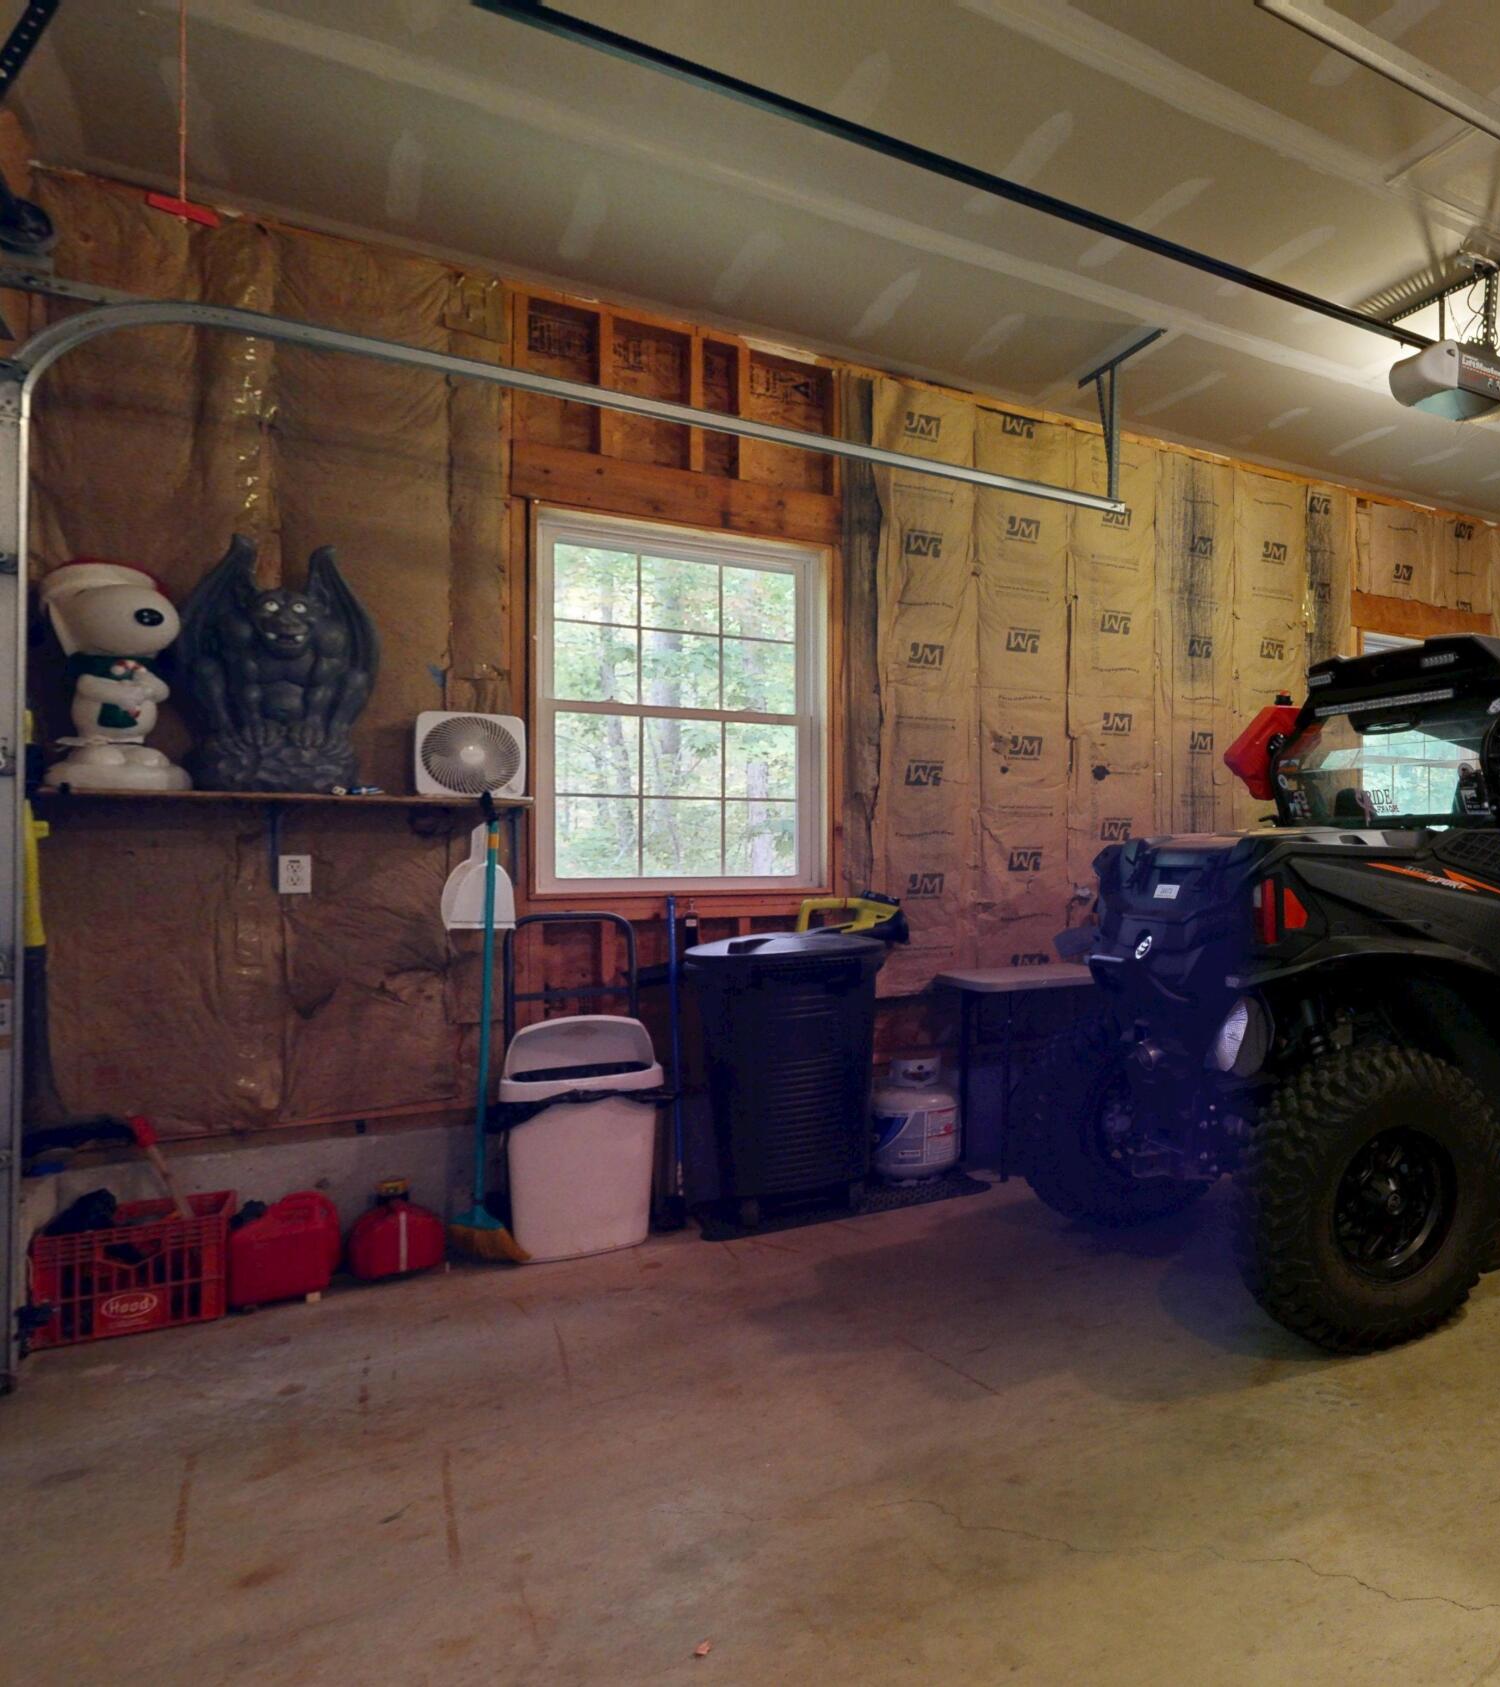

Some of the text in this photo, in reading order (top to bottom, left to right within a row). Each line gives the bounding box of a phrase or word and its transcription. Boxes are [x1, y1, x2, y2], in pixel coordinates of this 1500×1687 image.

[905, 411, 941, 438] JM
[1007, 517, 1040, 540] JM
[905, 532, 943, 558] JM
[1262, 542, 1287, 561] JM
[1101, 612, 1131, 635] JM
[1007, 631, 1040, 653] JM
[909, 643, 944, 667] JM
[1102, 713, 1132, 732] JM
[1009, 736, 1042, 756] JM
[905, 763, 943, 786] JM
[1008, 852, 1041, 871] JM
[908, 873, 944, 896] JM
[1425, 875, 1467, 889] SPORT
[110, 1297, 150, 1313] Hood
